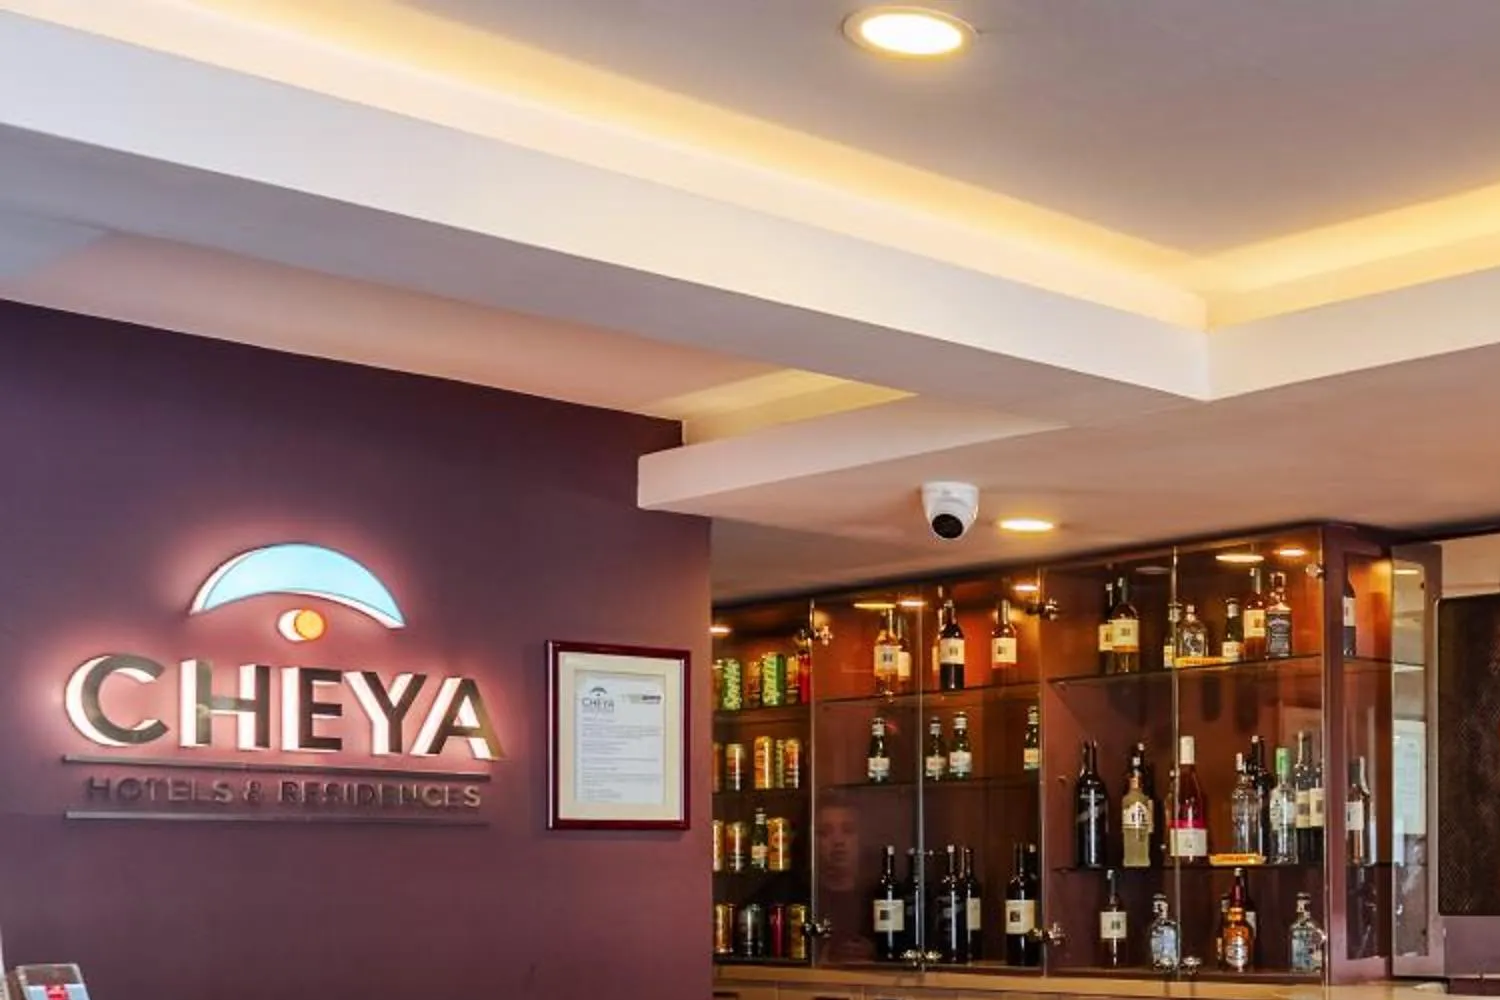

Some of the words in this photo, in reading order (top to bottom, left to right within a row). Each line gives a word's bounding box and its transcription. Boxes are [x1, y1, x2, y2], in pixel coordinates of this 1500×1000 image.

[65, 653, 505, 760] CHEYA
[86, 775, 234, 804] HOTELS
[243, 780, 265, 803] &
[277, 779, 482, 809] RESIDENCES
